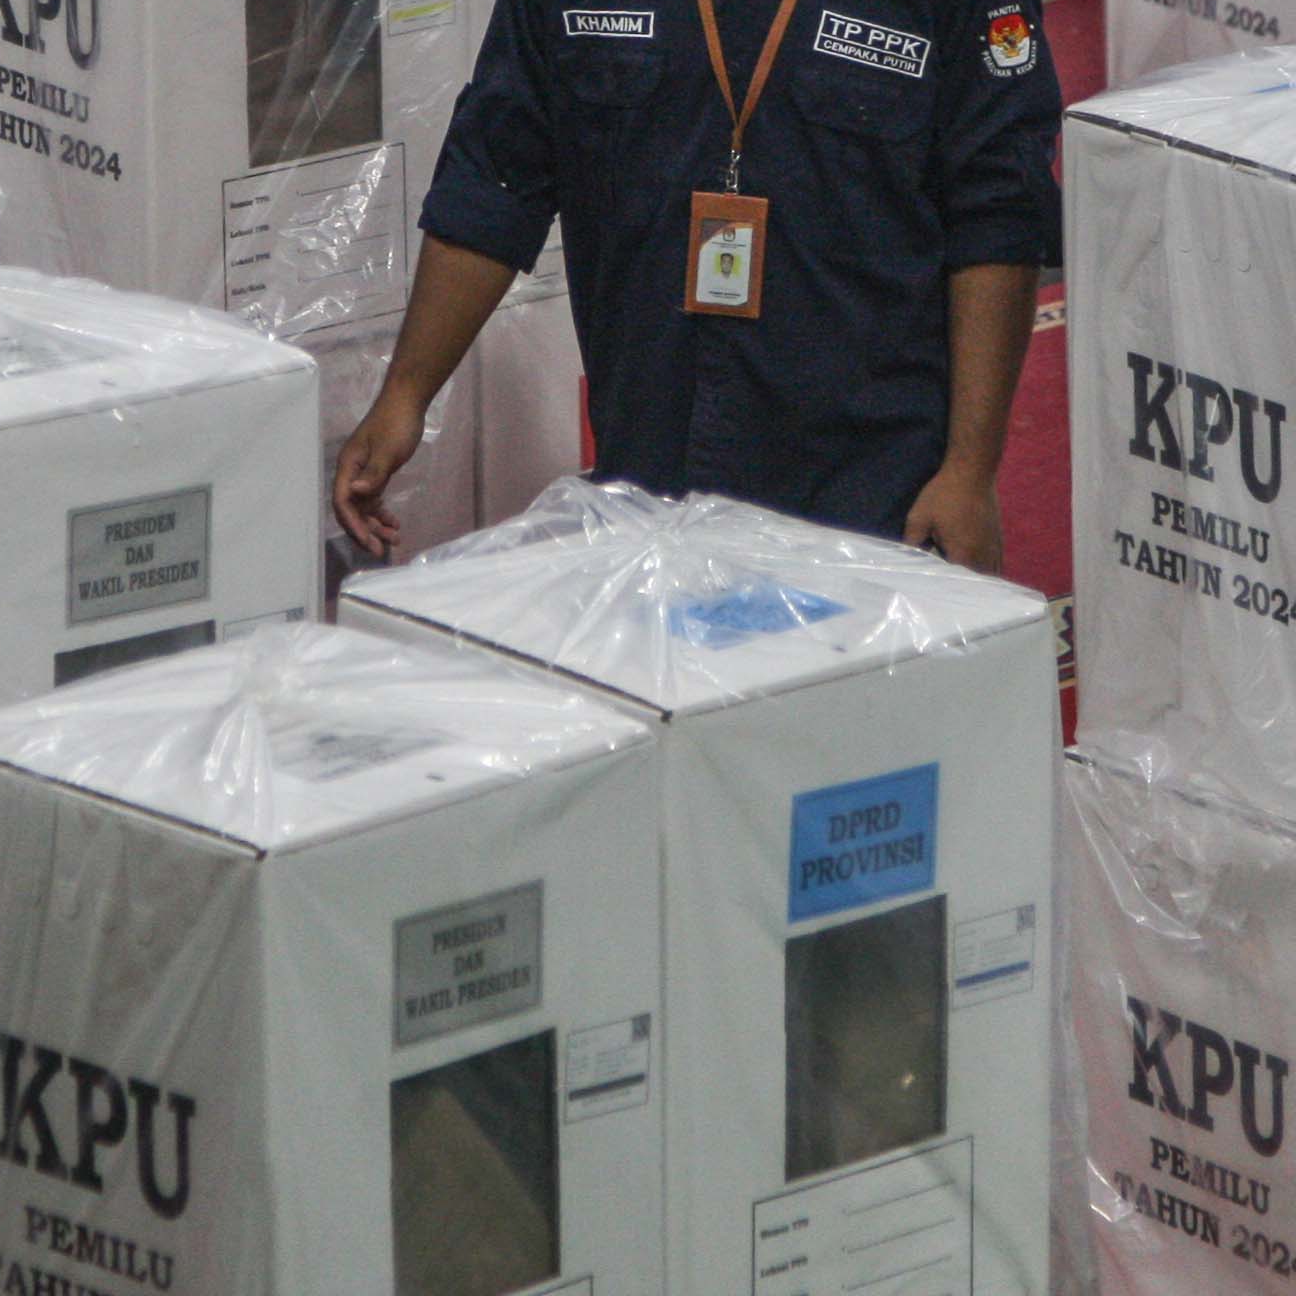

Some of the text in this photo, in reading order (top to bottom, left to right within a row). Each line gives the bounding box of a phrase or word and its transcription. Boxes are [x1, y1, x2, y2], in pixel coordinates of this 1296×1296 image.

[576, 15, 643, 33] KHAMIM
[829, 17, 921, 58] TP PPK
[1224, 2, 1281, 40] 2024
[823, 39, 916, 72] CEMPAKA PUTIH
[60, 134, 122, 182] 2024
[1126, 350, 1286, 504] KPU
[104, 512, 177, 543] PRESIDEN
[1151, 491, 1270, 564] PEMILU
[125, 543, 154, 565] DAN
[1114, 529, 1222, 600] TAHUN
[78, 559, 200, 601] WAKIL PRESIDEN
[829, 801, 901, 846] DPRD
[800, 832, 925, 891] PROVINSI
[431, 913, 505, 955] PRESIDEN
[453, 950, 485, 980] DAN
[405, 963, 532, 1021] WAKIL PRESIDEN
[1127, 996, 1288, 1158] KPU
[1149, 1136, 1270, 1215] PEMILU
[1114, 1171, 1220, 1249] TAHUN
[24, 1205, 174, 1291] PEMILU
